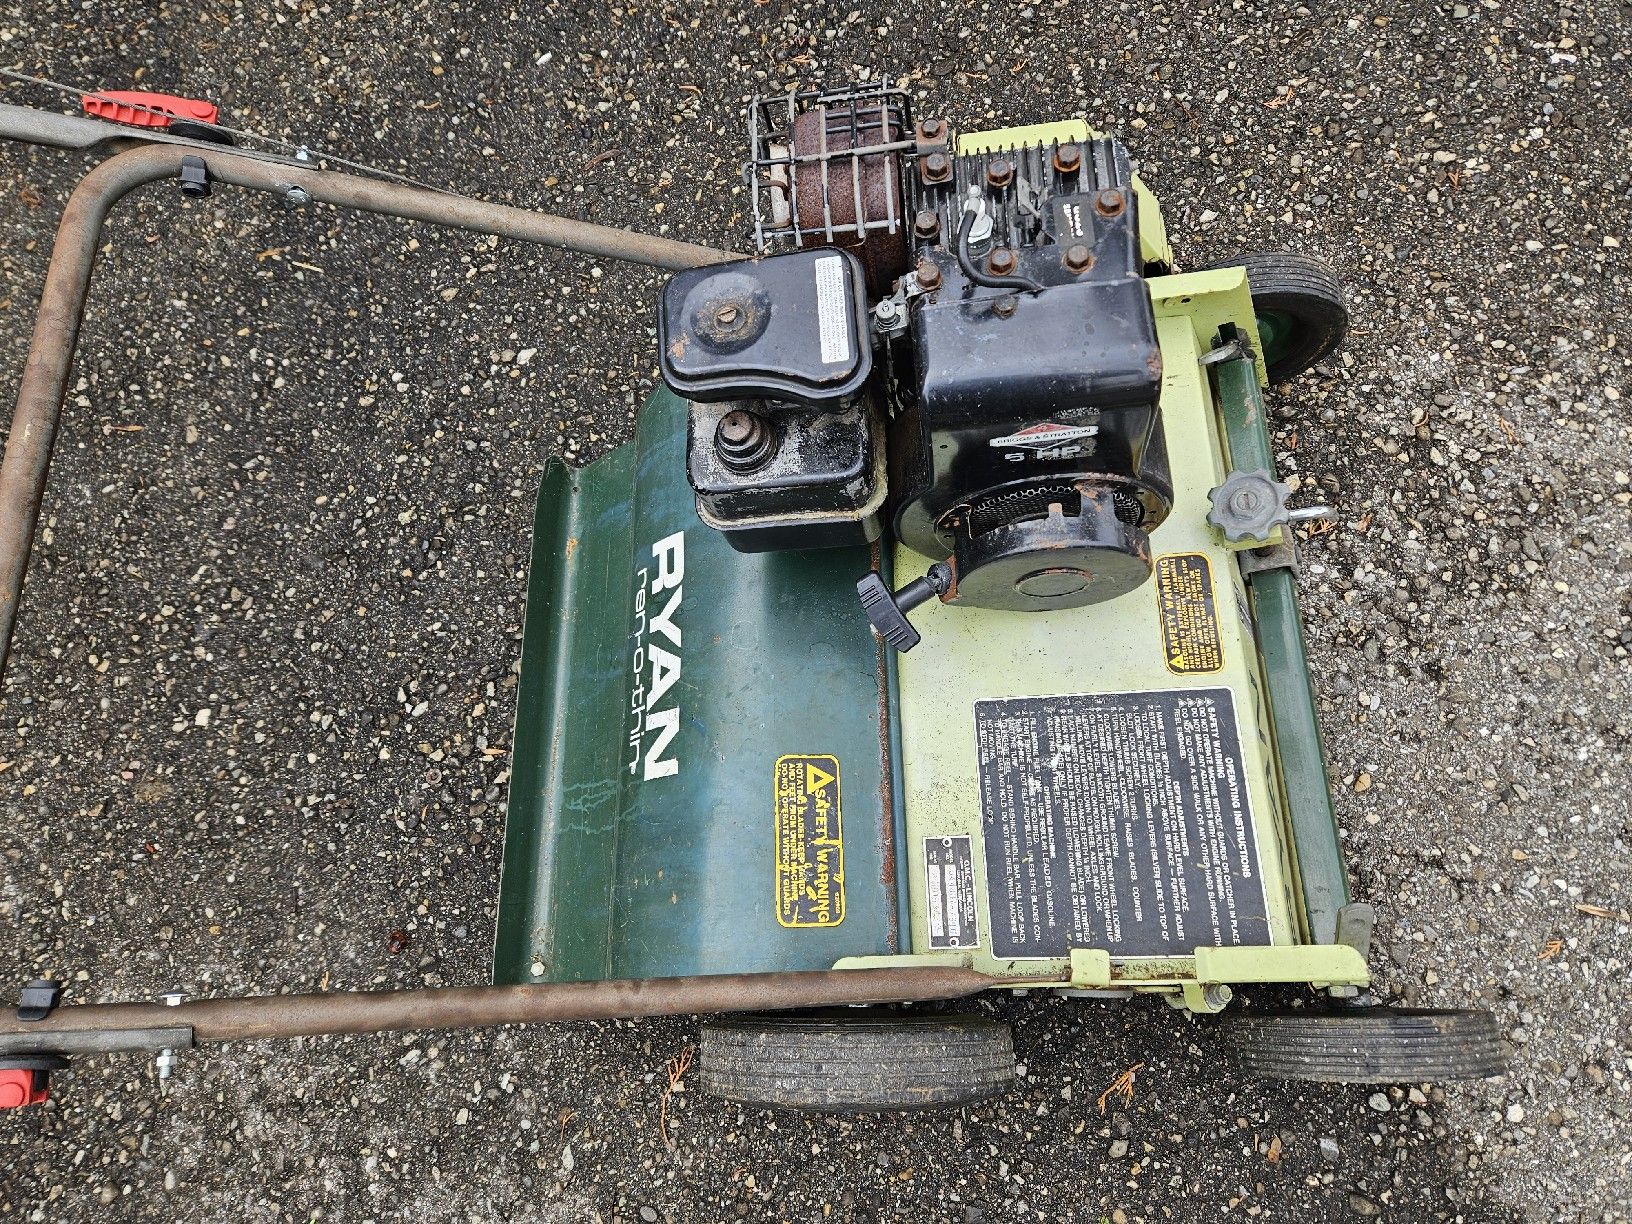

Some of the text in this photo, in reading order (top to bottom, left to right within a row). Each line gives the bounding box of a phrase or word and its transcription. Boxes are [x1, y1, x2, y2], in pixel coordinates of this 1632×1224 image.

[997, 436, 1032, 444] BRIGGS
[1043, 428, 1091, 439] STRATTON
[1005, 446, 1081, 462] 5 HP
[1159, 559, 1180, 654] SAFETY WARNING
[644, 531, 684, 781] RYAN
[629, 568, 648, 774] ren-o-thin
[1148, 711, 1156, 732] START
[1155, 712, 1164, 729] MAKE
[1151, 734, 1159, 750] WITH
[1194, 734, 1203, 752] MAKE
[1202, 734, 1213, 763] OPERATE
[1207, 706, 1225, 778] SAFETY WARNING
[1161, 751, 1169, 773] DEPTH
[1186, 747, 1195, 766] OVER
[1190, 775, 1198, 790] SIDE
[1199, 768, 1213, 818] ADJUSTMENTS
[1207, 766, 1217, 795] MACHINE
[1143, 788, 1152, 818] LOCKING
[1158, 789, 1166, 805] INCH
[1164, 775, 1176, 818] ADJUSTMENT
[1193, 792, 1202, 812] WALK
[1043, 786, 1056, 858] OPERATING MACHINE
[1160, 808, 1170, 831] ABOVE
[1172, 780, 1189, 856] DEPTH ADJUSTMENTS
[1212, 798, 1222, 829] WITHOUT
[1224, 757, 1251, 878] OPERATING INSTRUCTIONS
[1147, 820, 1156, 847] LEVERS
[1172, 832, 1180, 851] HARD
[1207, 820, 1216, 837] WITH
[815, 788, 828, 922] SAFETY WARNING
[1164, 833, 1174, 866] SURFACE
[1210, 839, 1220, 864] ENGINE
[1216, 831, 1227, 860] GUARDS
[1042, 852, 1051, 886] LEADED
[1174, 853, 1183, 875] LEVEL
[1154, 880, 1163, 900] SLIDE
[1204, 870, 1213, 888] HARD
[1223, 874, 1234, 908] CATCHER
[1132, 886, 1142, 921] COUNTER
[1169, 878, 1180, 911] FURTHER
[1207, 891, 1218, 925] SURFACE
[1174, 913, 1184, 940] ADJUST
[1212, 928, 1221, 946] WITH
